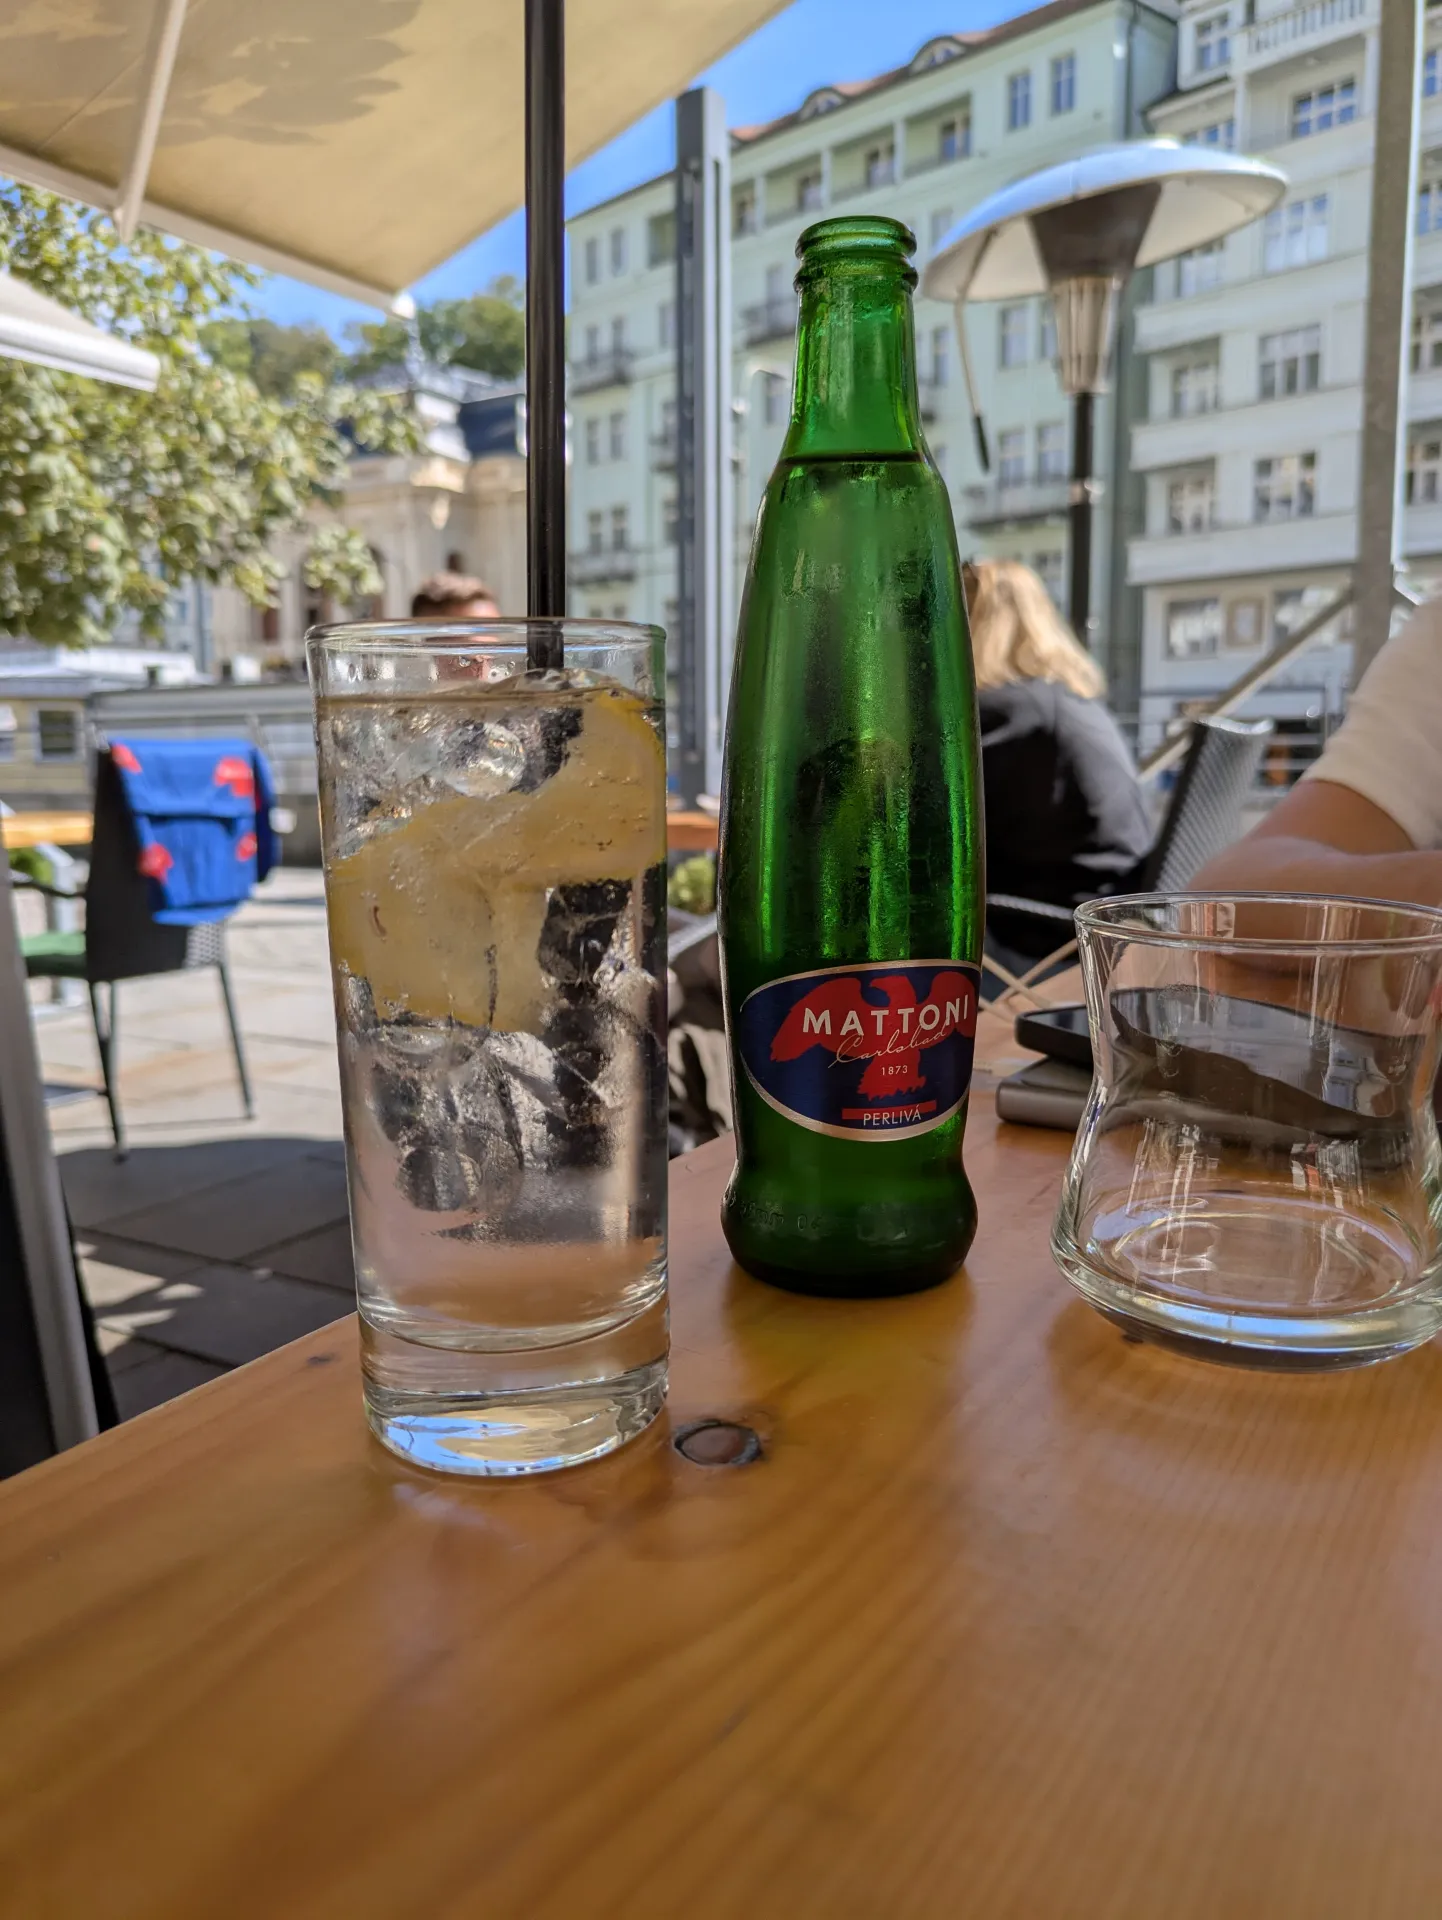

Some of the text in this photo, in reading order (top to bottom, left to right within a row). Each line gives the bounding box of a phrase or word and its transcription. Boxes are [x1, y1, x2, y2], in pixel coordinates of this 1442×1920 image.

[802, 994, 969, 1036] MATTONI
[828, 1024, 948, 1068] Carlsbad
[881, 1064, 908, 1076] 1873
[862, 1104, 922, 1127] PERLIVÁ
